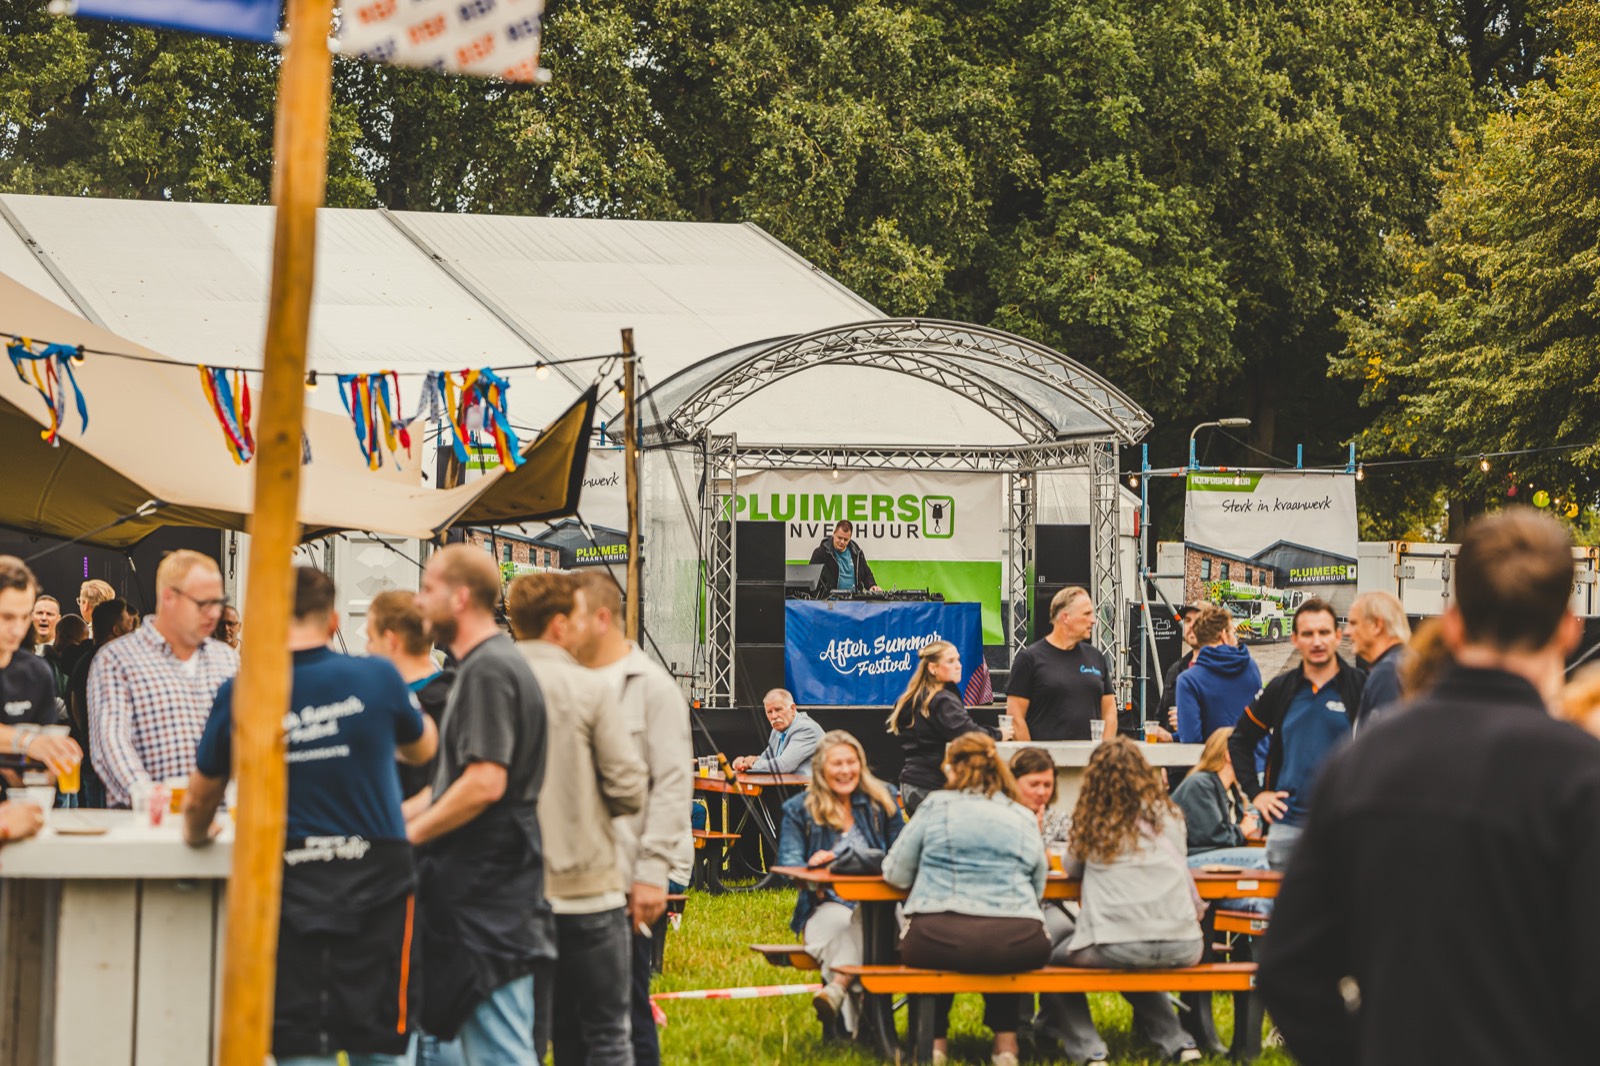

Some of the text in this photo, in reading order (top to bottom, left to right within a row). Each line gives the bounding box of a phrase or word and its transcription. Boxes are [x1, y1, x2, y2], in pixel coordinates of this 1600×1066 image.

[1191, 475, 1251, 486] HOOFDSPONOR
[722, 493, 921, 522] PLUIMERS
[1222, 495, 1333, 513] Sterk in kraanwerk
[790, 522, 920, 539] NVEHUUR
[1290, 565, 1346, 578] PLUIMERS
[1290, 574, 1346, 583] KRAANVERHUUR
[820, 638, 871, 670] After
[857, 652, 912, 676] Festival
